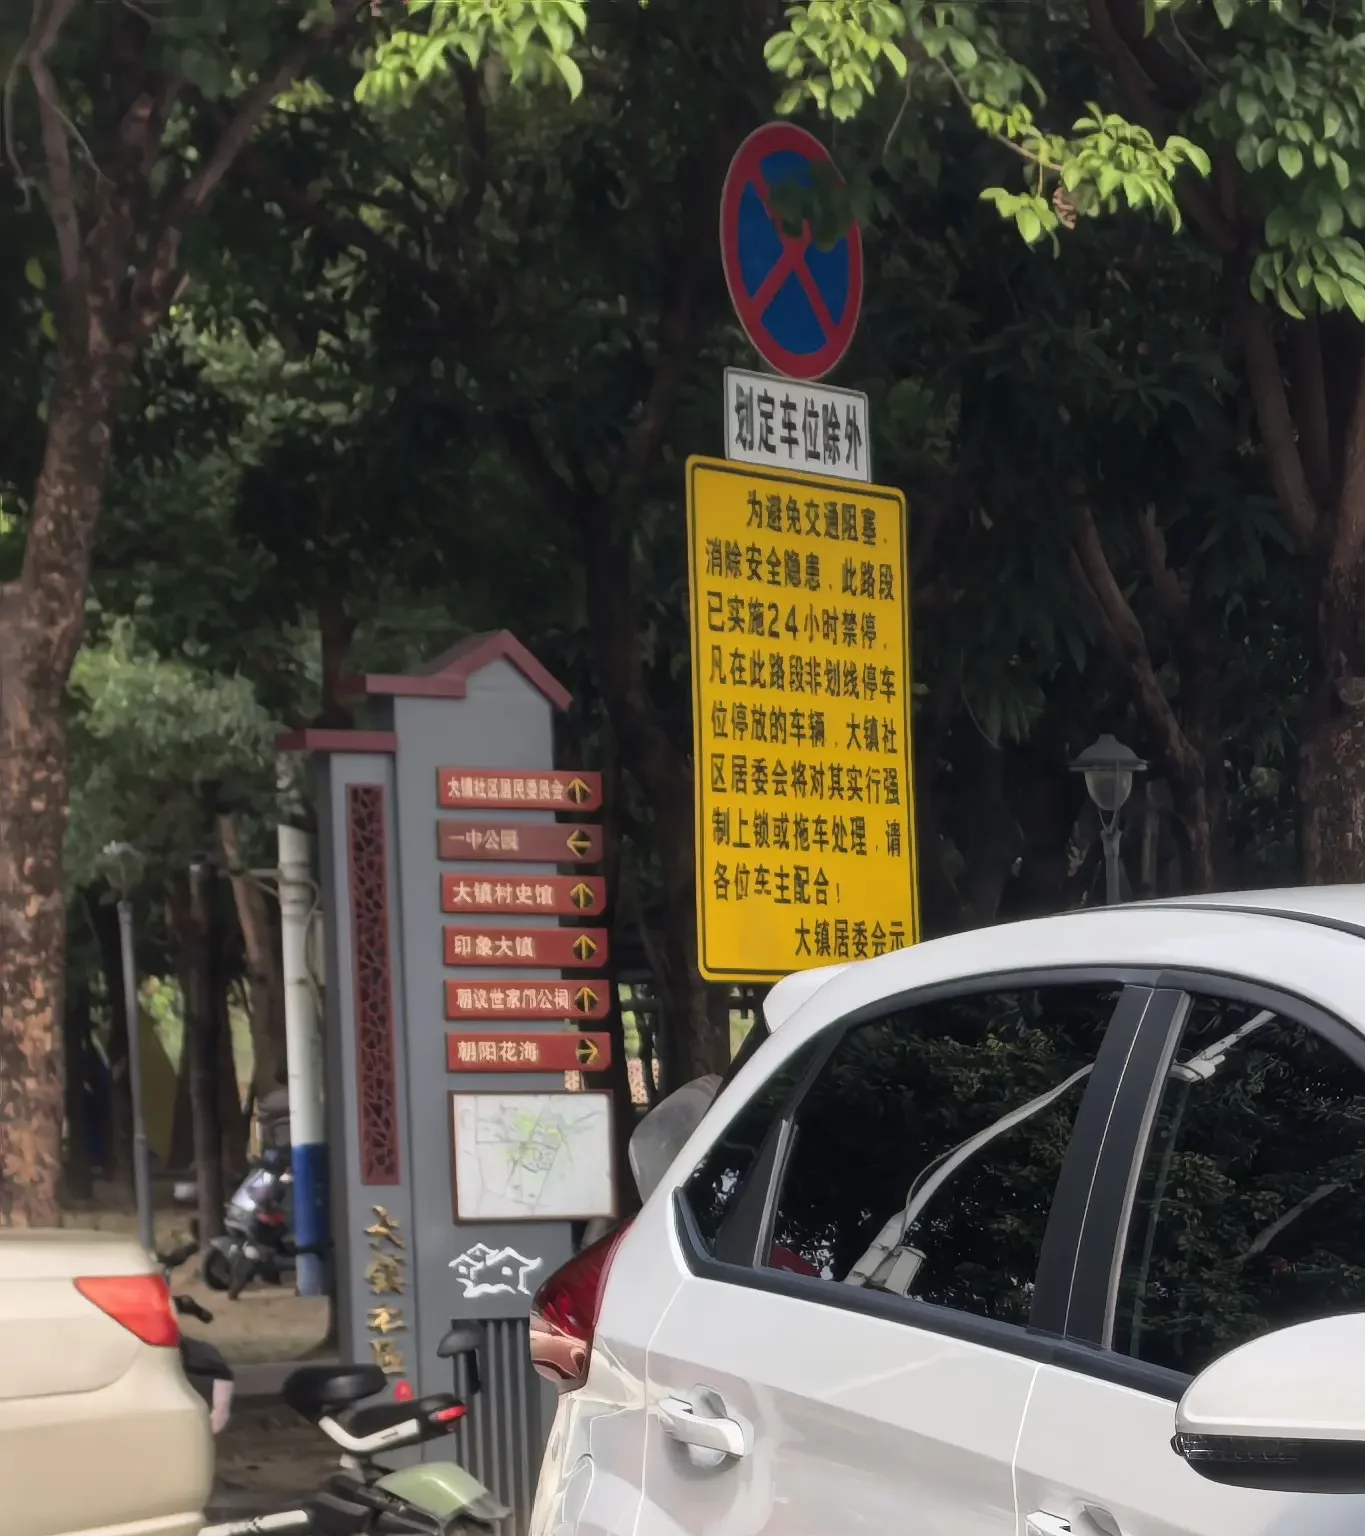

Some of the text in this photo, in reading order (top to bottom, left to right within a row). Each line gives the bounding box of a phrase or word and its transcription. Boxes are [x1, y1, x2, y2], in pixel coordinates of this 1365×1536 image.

[735, 382, 862, 471] 划定车位除外
[709, 644, 895, 704] 凡在此路段非划线停车
[711, 753, 900, 805] 区居委会将对其实行强
[452, 881, 553, 905] 大镇村史馆
[454, 935, 535, 959] 印象大镇
[457, 1040, 538, 1063] 朝阳花海
